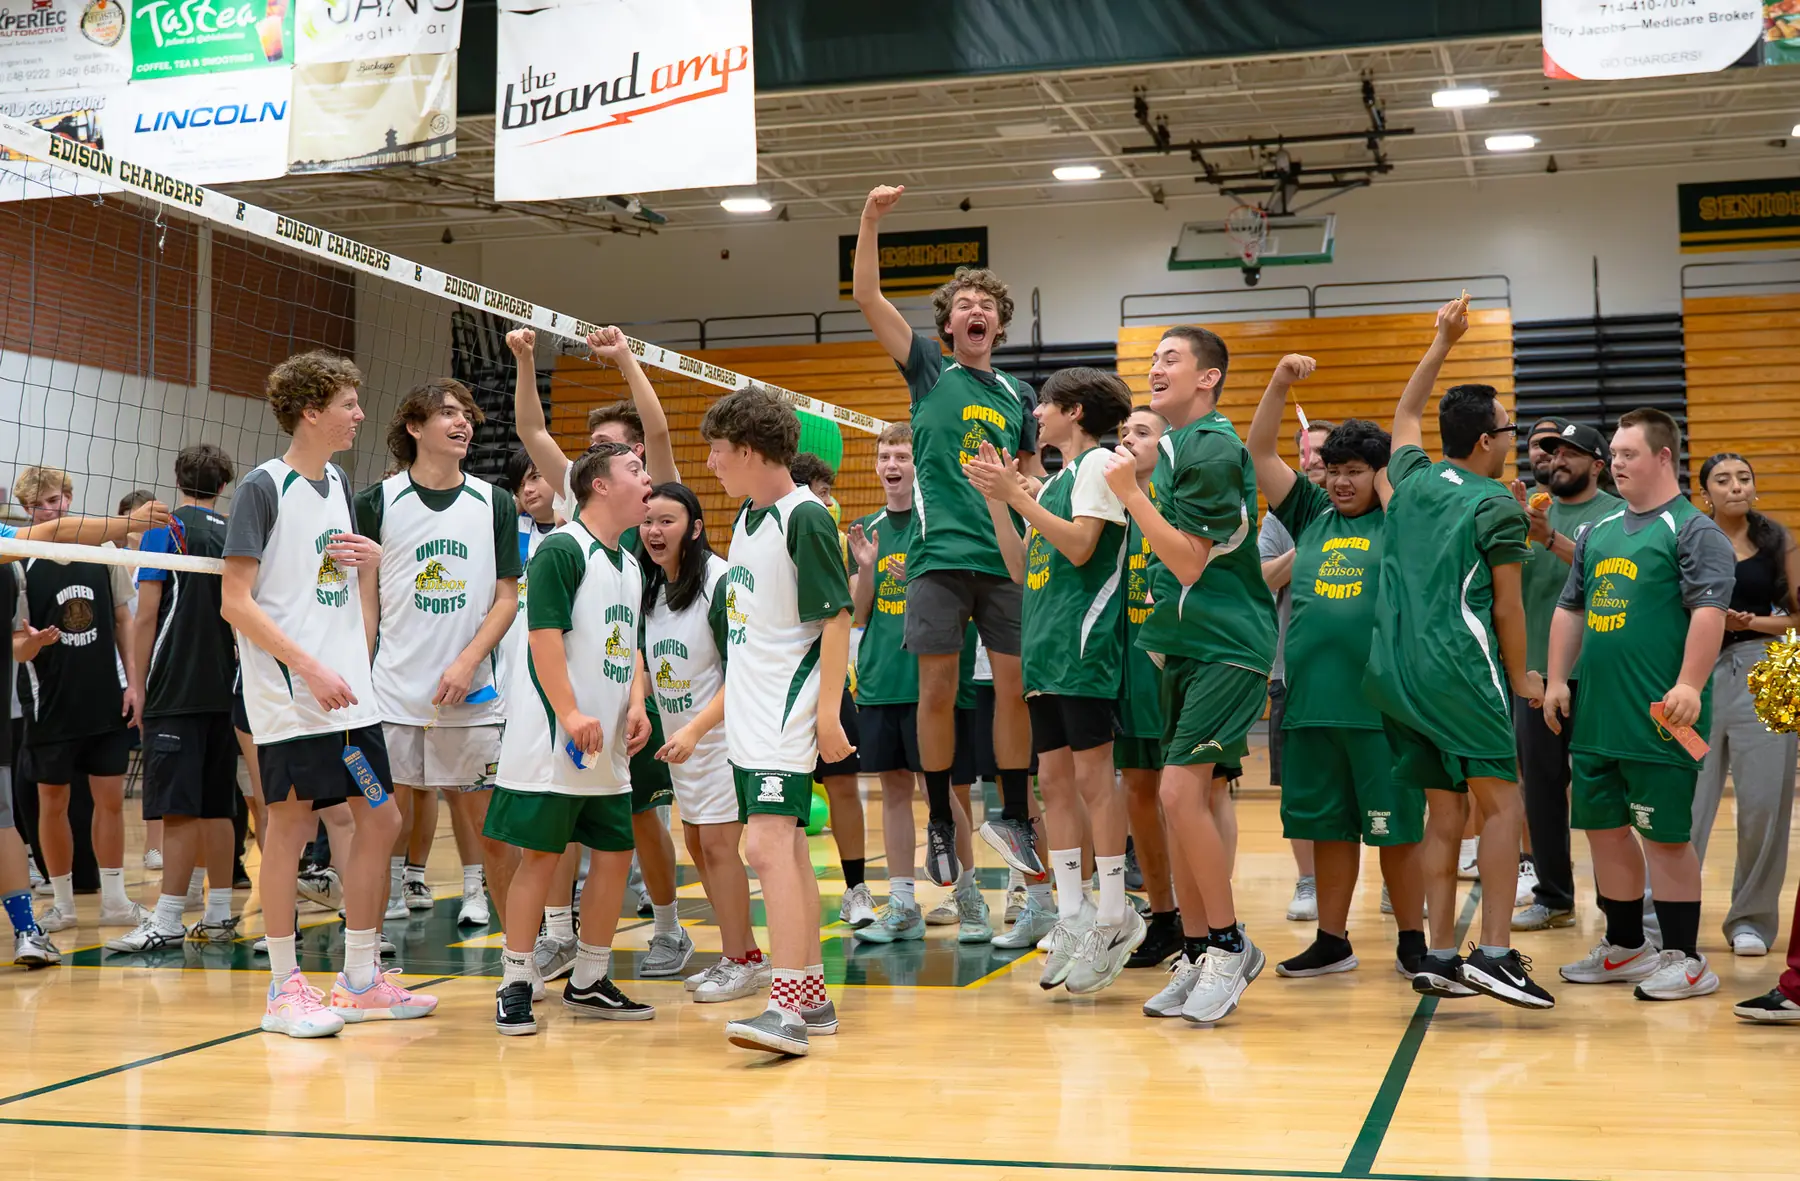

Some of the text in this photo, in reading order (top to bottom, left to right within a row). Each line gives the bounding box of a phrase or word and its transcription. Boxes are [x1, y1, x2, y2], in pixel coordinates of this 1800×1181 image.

[1548, 23, 1574, 36] Troy
[1708, 11, 1755, 23] Broker
[502, 45, 748, 130] brand amp
[520, 66, 556, 94] the
[134, 100, 288, 133] LINCOLN
[49, 134, 204, 207] EDISON CHARGERS
[276, 216, 391, 271] EDISON CHARGERS
[444, 276, 533, 319] EDISON CHARGERS
[679, 356, 737, 386] EDISON CHARGERS
[962, 405, 1007, 431] UNIFIED
[415, 538, 468, 562] UNIFIED
[1321, 537, 1371, 552] UNIFIED
[1319, 567, 1364, 577] EDISON
[1594, 557, 1638, 581] UNIFIED
[56, 585, 94, 606] UNIFIED
[417, 579, 468, 591] EDISON
[1314, 578, 1363, 599] SPORTS
[414, 592, 467, 614] SPORTS
[1592, 597, 1629, 609] EDISON
[1587, 610, 1627, 632] SPORTS
[60, 628, 98, 647] SPORTS
[653, 639, 688, 660] UNIFIED
[1630, 802, 1655, 812] Edison
